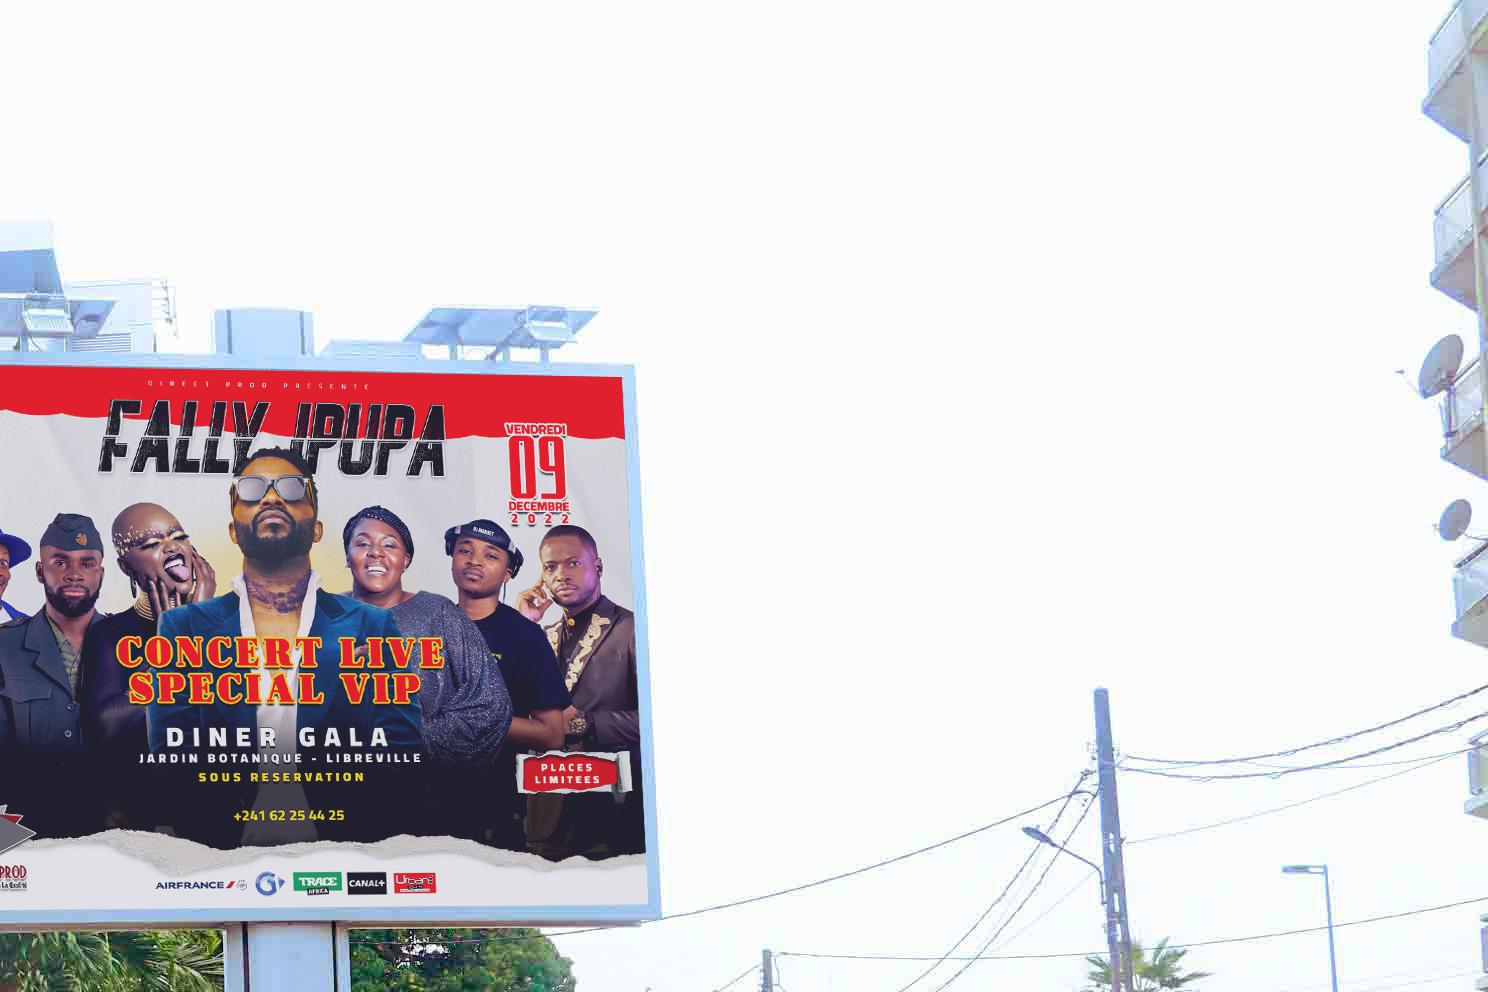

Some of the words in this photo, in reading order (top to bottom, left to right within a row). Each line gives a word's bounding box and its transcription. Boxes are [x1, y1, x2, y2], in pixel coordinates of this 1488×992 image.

[283, 382, 369, 390] PRESENTE
[505, 423, 567, 435] VENDREDI
[98, 399, 271, 474] FALLY
[290, 401, 446, 477] IPUPA
[508, 435, 567, 499] 09
[508, 501, 570, 512] DECEMBRE
[510, 513, 569, 524] 2022
[116, 636, 322, 668] CONCERT
[338, 637, 444, 669] LIVE
[128, 673, 325, 704] SPECIAL
[339, 673, 422, 704] VIP
[166, 727, 277, 748] DINER
[299, 727, 389, 748] GALA
[139, 753, 199, 764] JARDIN
[208, 753, 303, 765] BOTANIQUE
[326, 753, 421, 764] LIBREVILLE
[540, 763, 593, 772] PLACES
[198, 772, 242, 783] SOUS
[250, 772, 364, 783] RESERVATION
[535, 775, 600, 784] LIMITEES
[233, 810, 265, 821] +241
[269, 810, 286, 821] 62
[289, 810, 305, 821] 25
[308, 810, 325, 821] 44
[328, 810, 345, 821] 25
[155, 881, 225, 889] AIRFRANCE
[298, 877, 338, 886] TRACE
[349, 879, 385, 887] CANAL+
[308, 887, 329, 895] AFRICA
